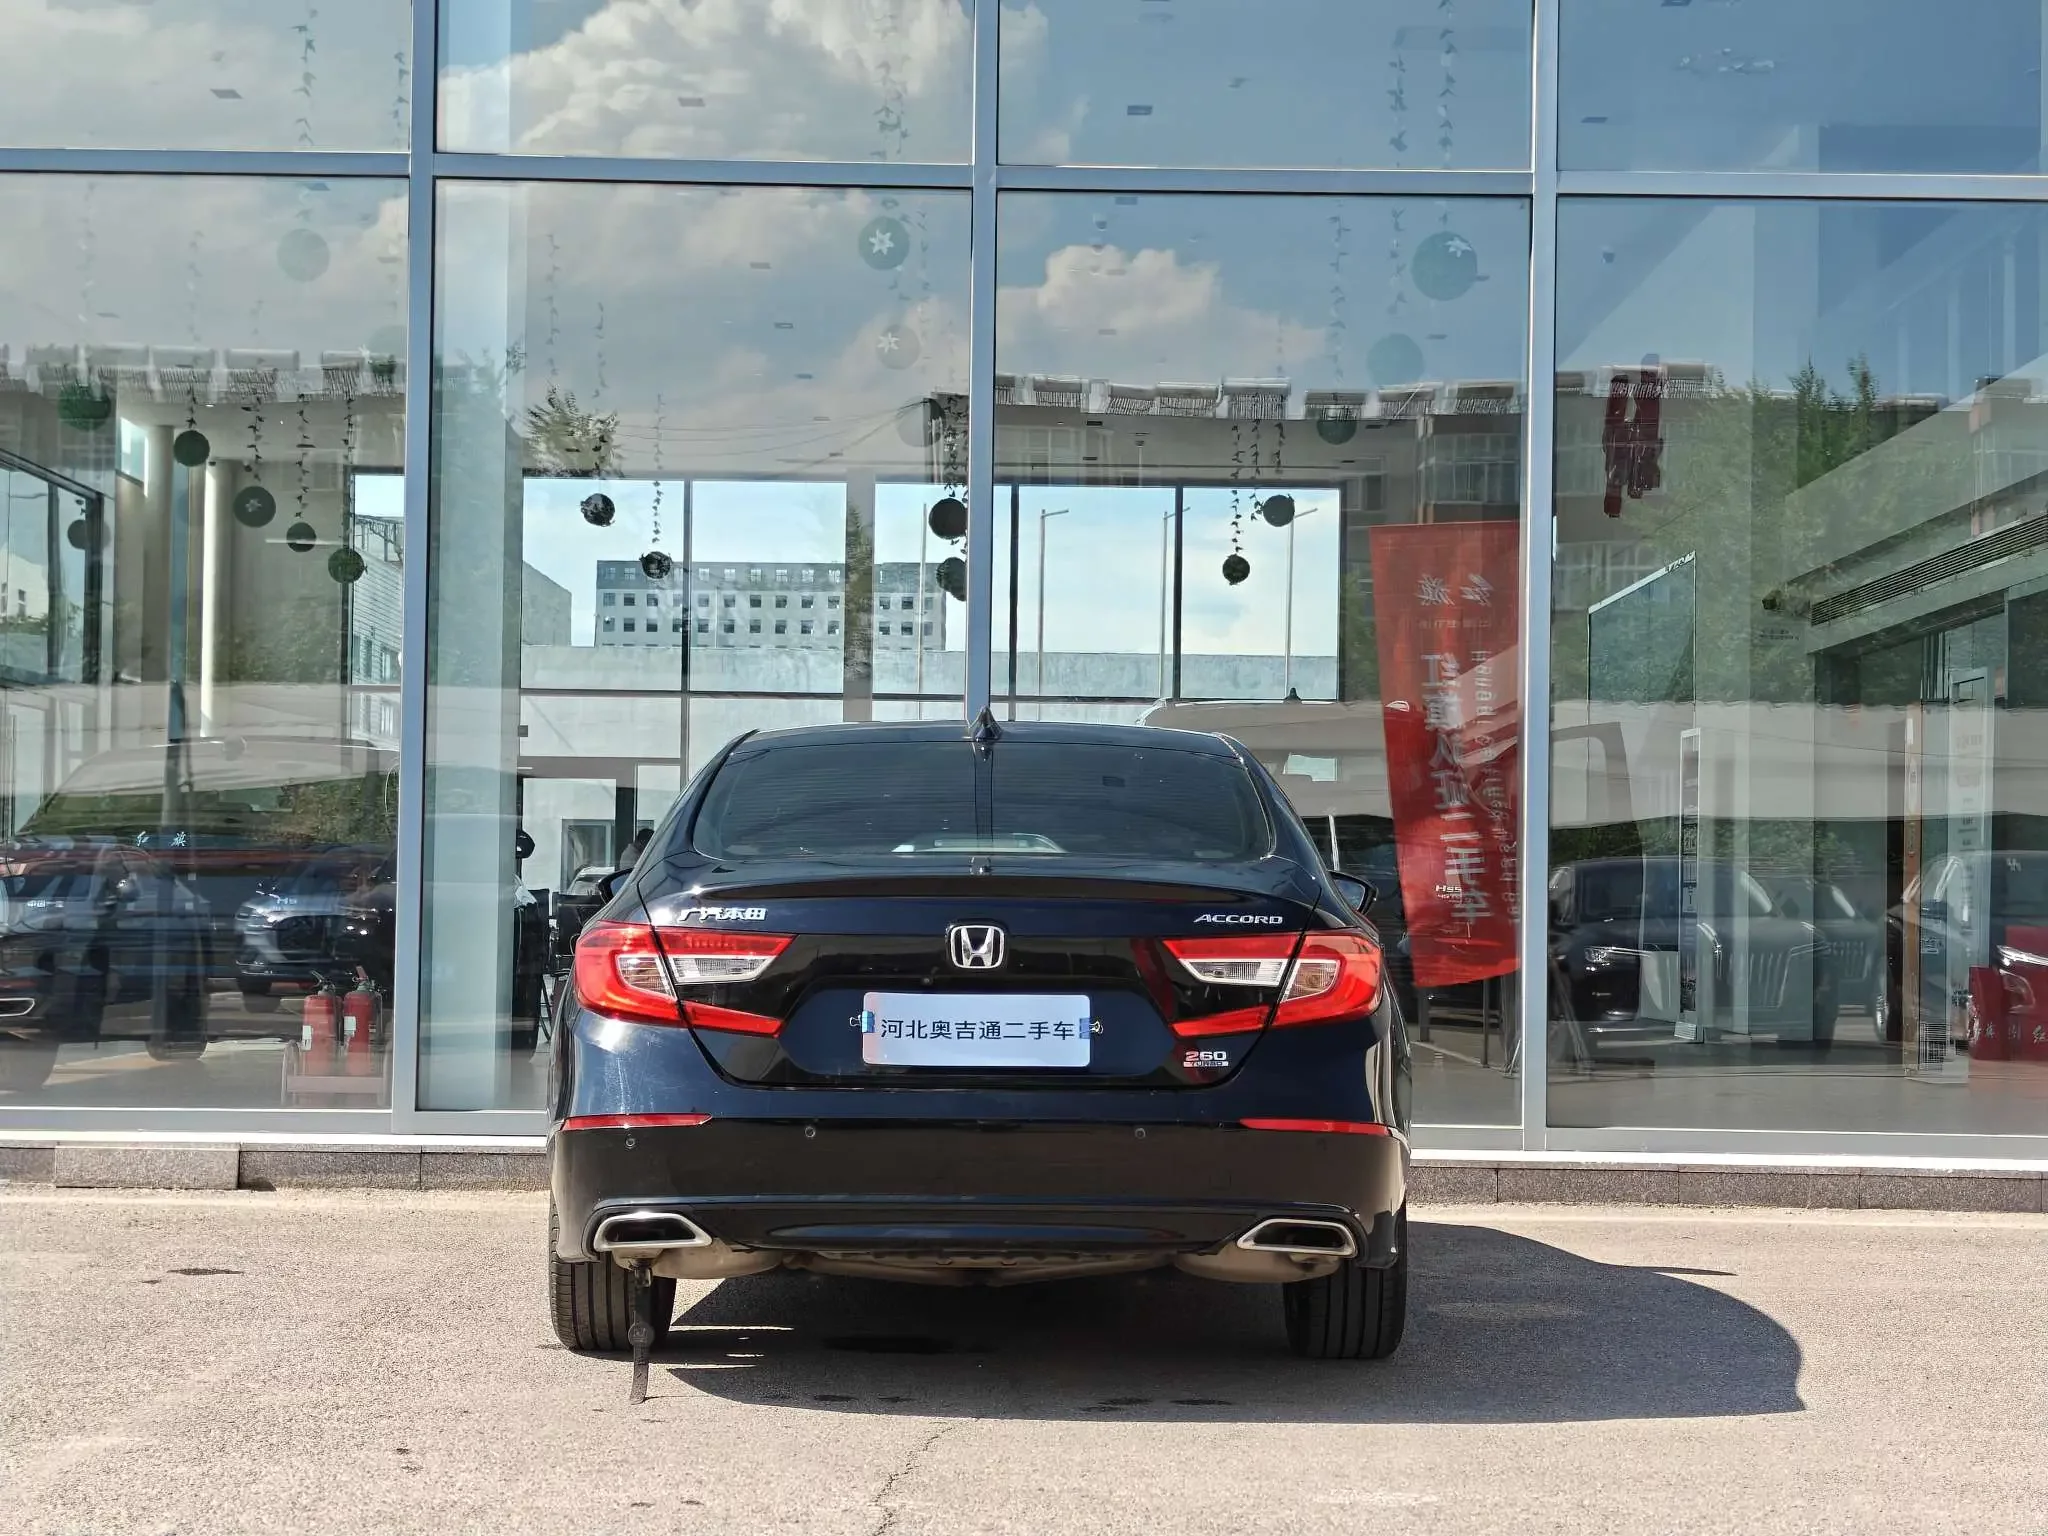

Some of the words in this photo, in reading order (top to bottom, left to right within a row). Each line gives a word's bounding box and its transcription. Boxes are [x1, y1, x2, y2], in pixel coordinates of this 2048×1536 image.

[677, 906, 767, 923] 广汽本田
[1193, 913, 1284, 925] ACCORD
[880, 1018, 1075, 1041] 河北奥吉通二手车
[1185, 1050, 1227, 1061] 260
